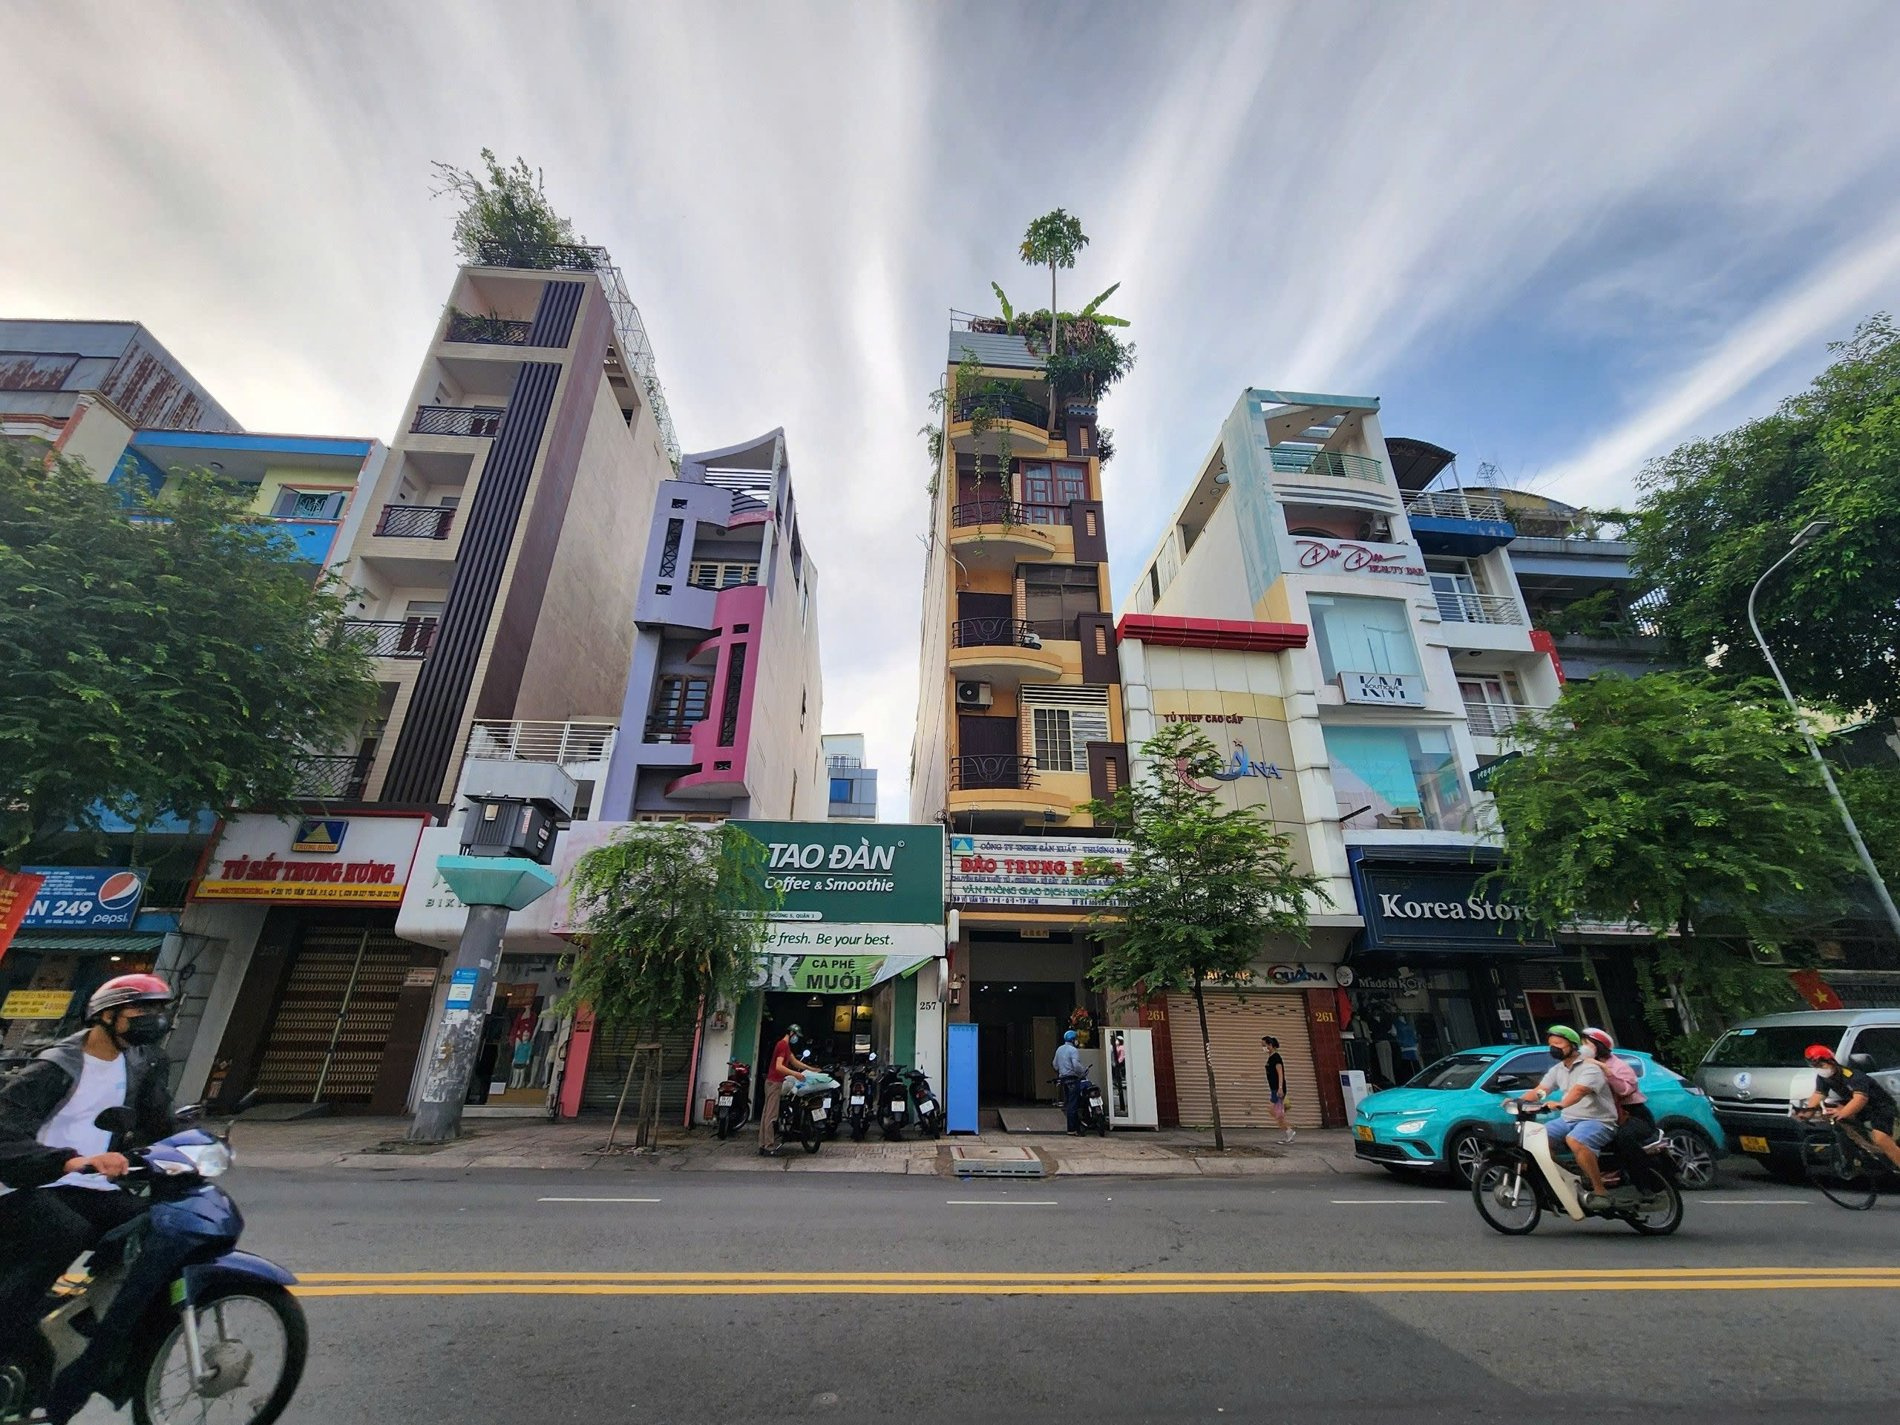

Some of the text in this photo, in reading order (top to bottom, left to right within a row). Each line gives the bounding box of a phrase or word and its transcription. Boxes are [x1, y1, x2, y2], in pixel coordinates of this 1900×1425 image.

[1367, 564, 1425, 577] BEAUTY BAR
[1360, 675, 1406, 699] KM
[1205, 714, 1224, 724] CAO
[768, 836, 896, 871] TAO ĐÀN
[282, 861, 344, 882] TRUNG
[1004, 858, 1067, 875] TRUNG
[764, 876, 895, 892] Coffee & Smoothie
[51, 900, 94, 917] 249
[1379, 893, 1540, 921] Korea Store
[92, 912, 128, 925] pepsi
[777, 932, 811, 947] fresh.
[816, 933, 832, 944] Be
[834, 935, 862, 948] your
[864, 933, 894, 945] best.
[812, 957, 855, 969] CÀ PHÊ
[919, 1001, 937, 1011] 257
[1147, 1010, 1335, 1023] 261 261
